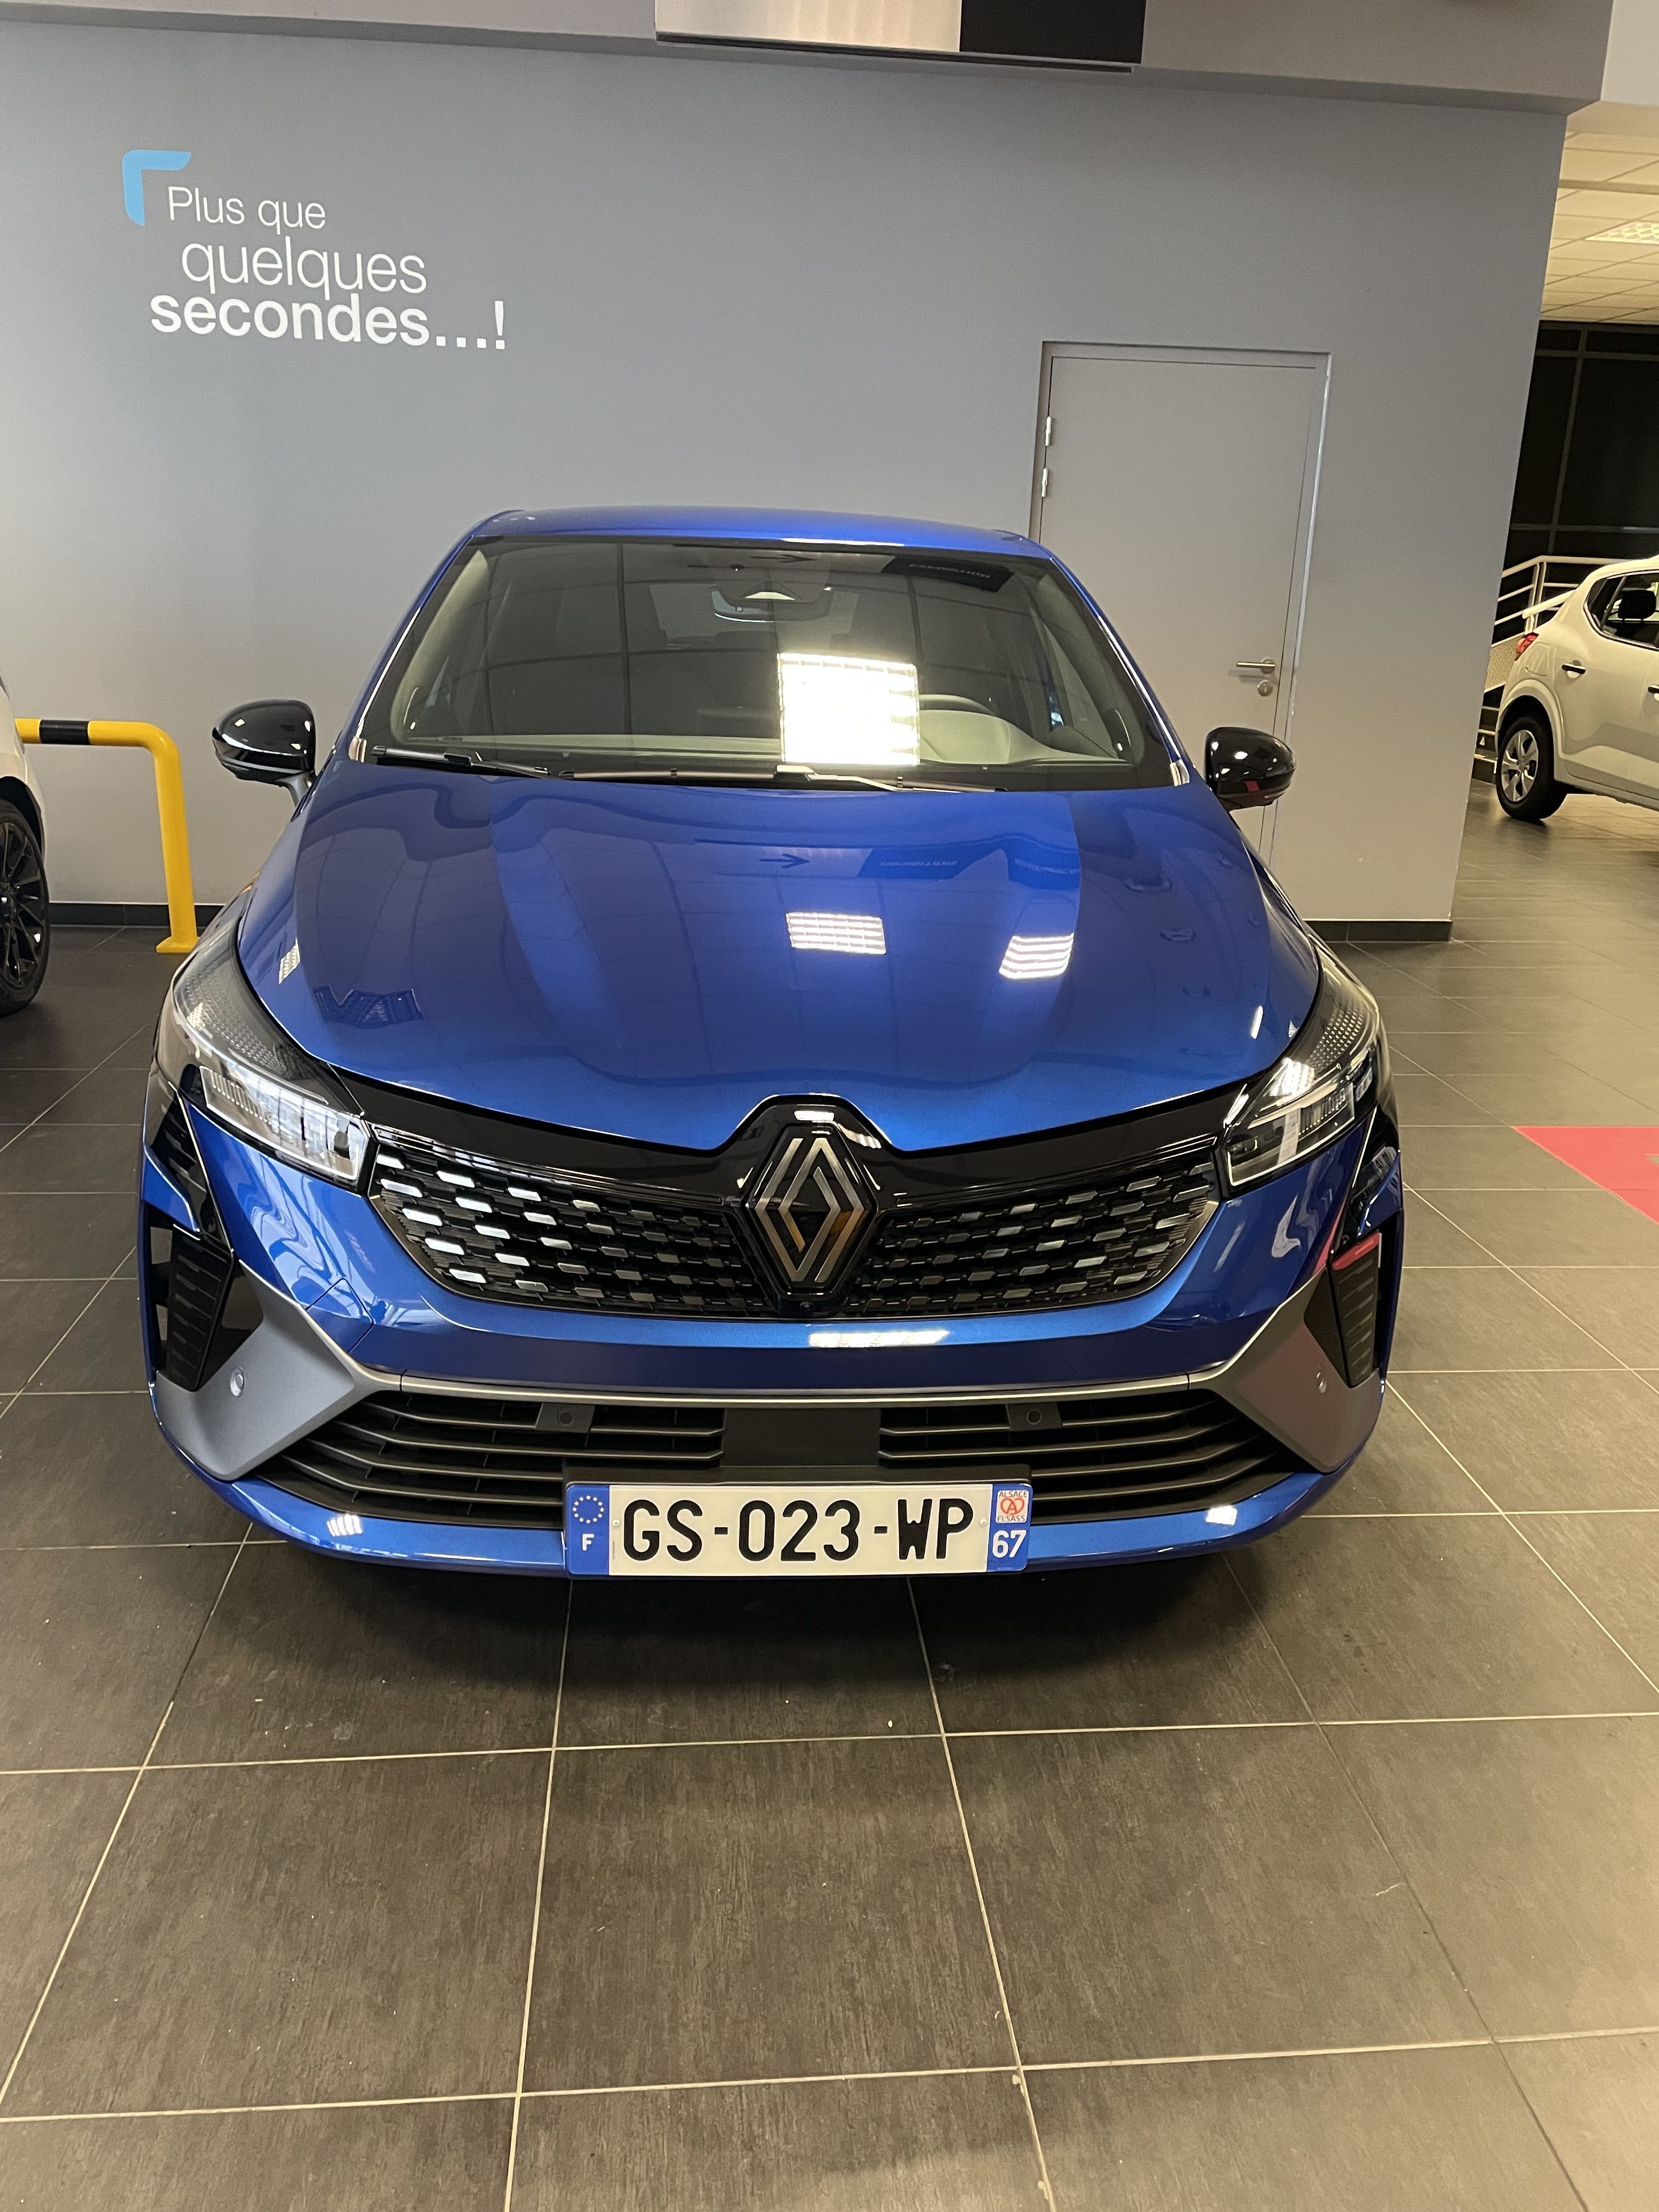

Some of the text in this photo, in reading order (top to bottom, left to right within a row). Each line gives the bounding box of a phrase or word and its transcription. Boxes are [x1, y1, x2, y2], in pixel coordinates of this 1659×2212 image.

[168, 186, 325, 235] Plus que
[182, 235, 427, 301] quelques
[582, 1533, 595, 1551] F
[623, 1498, 974, 1561] GS-023-WP
[992, 1530, 1027, 1558] 67
